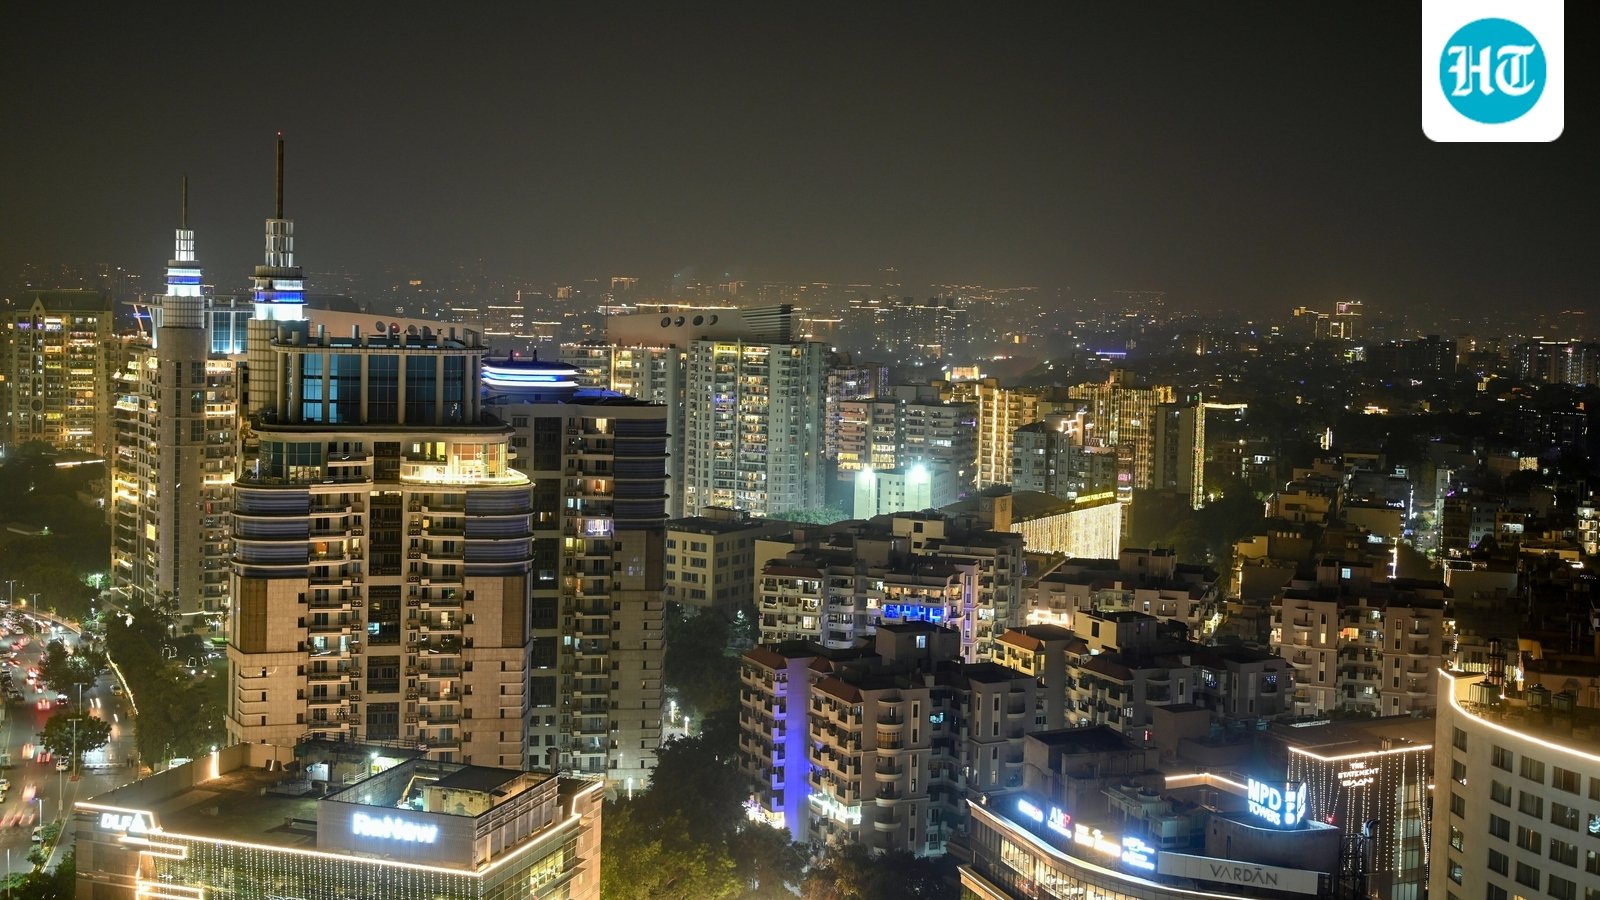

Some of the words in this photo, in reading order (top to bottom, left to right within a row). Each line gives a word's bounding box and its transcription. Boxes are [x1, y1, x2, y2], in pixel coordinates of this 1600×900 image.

[1338, 767, 1380, 780] STATEMENT
[1248, 778, 1282, 811] MPD
[101, 813, 133, 831] DLF
[1248, 799, 1281, 826] TOWERS
[353, 812, 438, 844] ReNew
